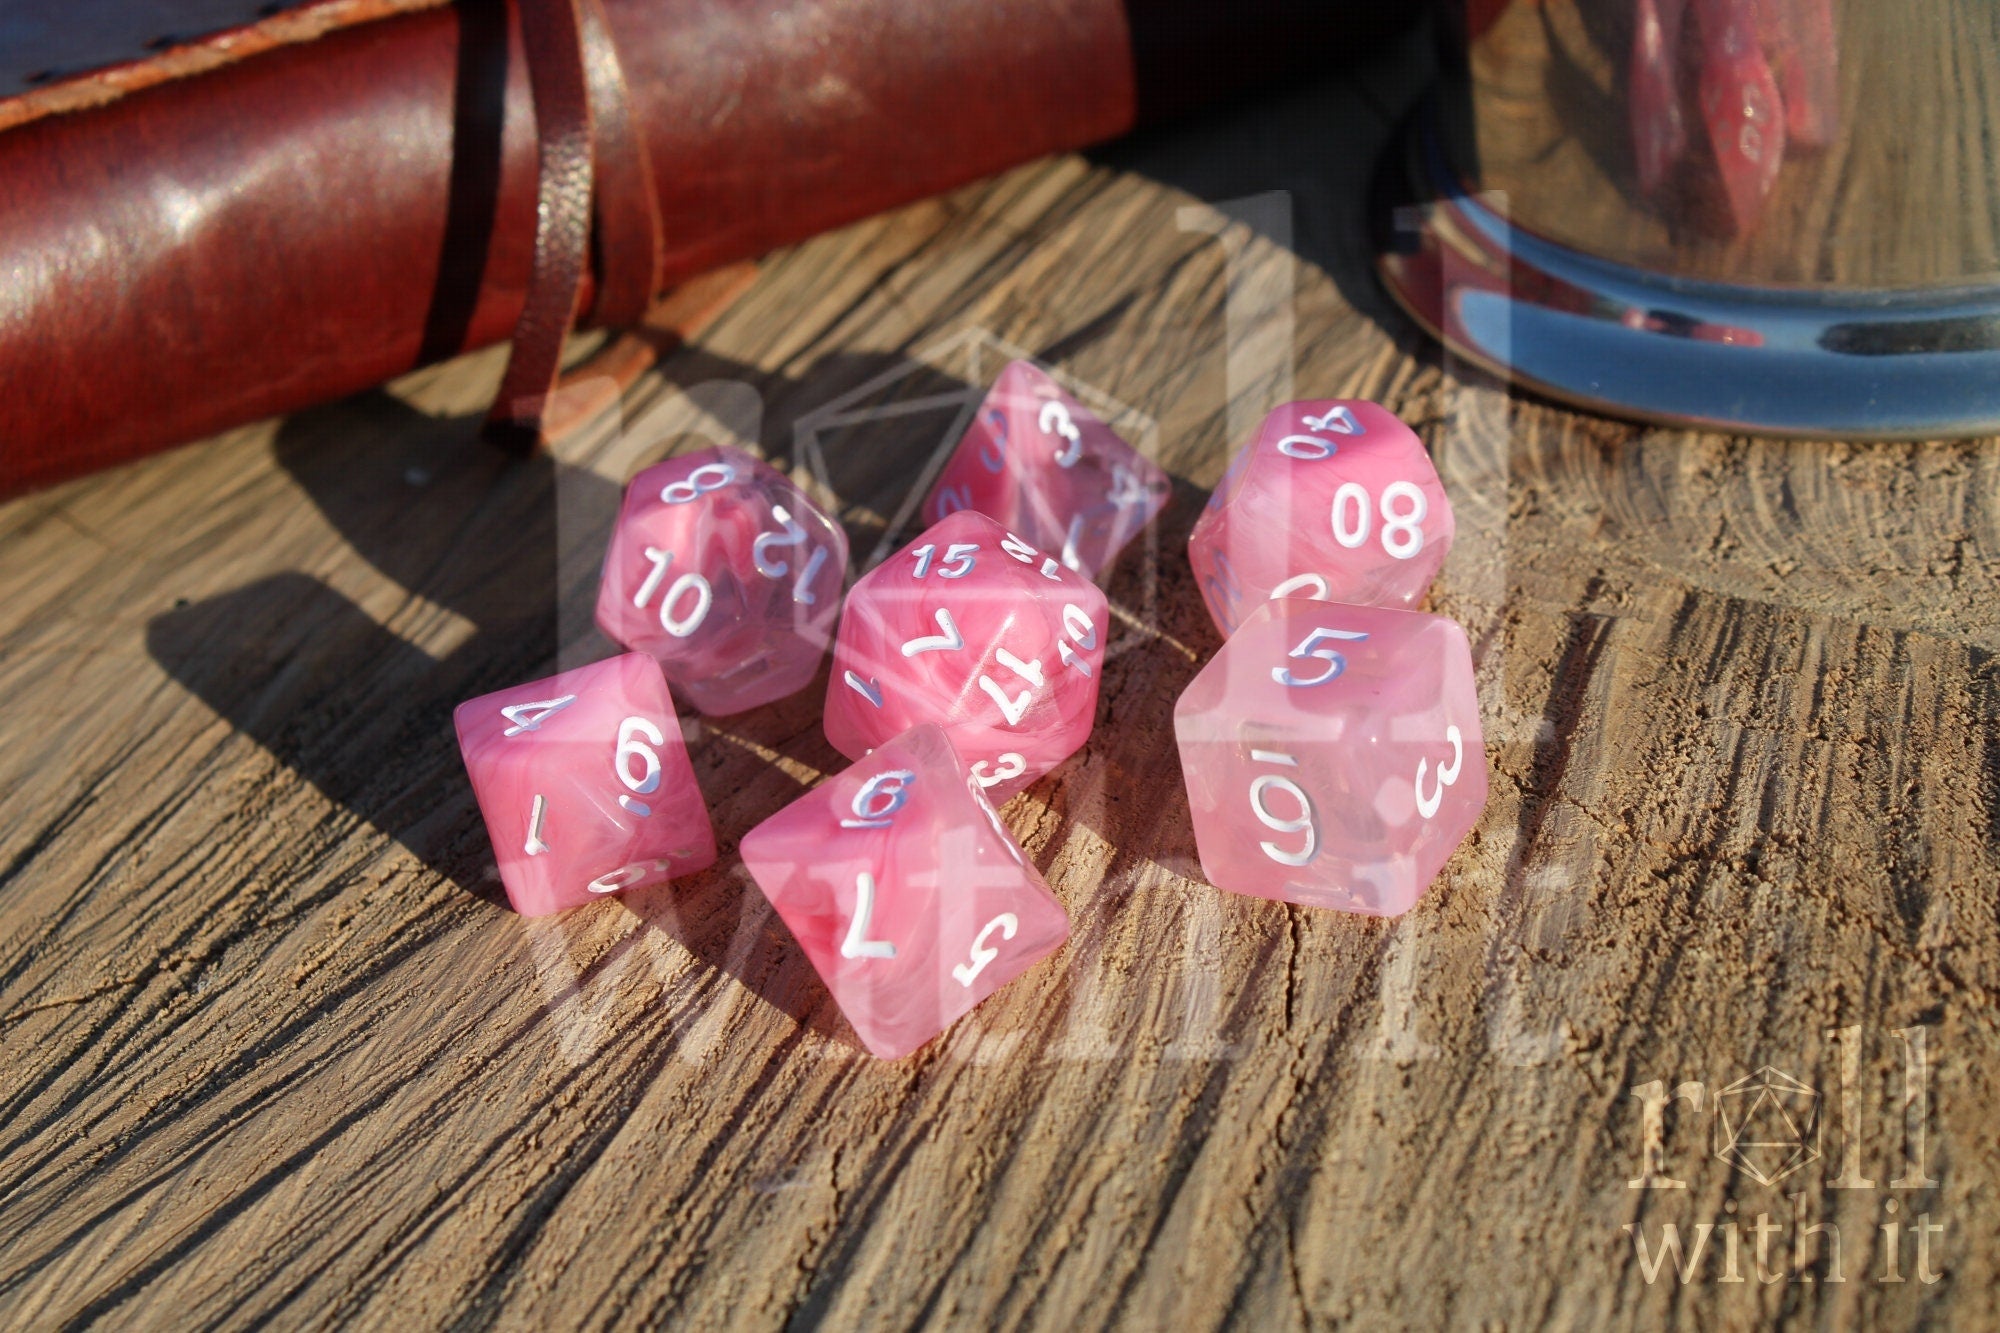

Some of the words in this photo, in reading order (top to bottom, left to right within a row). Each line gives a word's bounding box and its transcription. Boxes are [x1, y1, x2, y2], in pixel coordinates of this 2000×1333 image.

[1040, 400, 1081, 468] 3
[661, 463, 735, 504] 8
[633, 547, 712, 638] 10
[911, 544, 981, 579] 15
[901, 607, 965, 658] 7
[1057, 603, 1097, 678] 10
[1271, 628, 1370, 687] 5
[501, 694, 578, 737] 4
[978, 647, 1044, 726] 17
[1415, 724, 1463, 819] 3
[840, 872, 897, 958] 7
[952, 912, 1018, 987] 5
